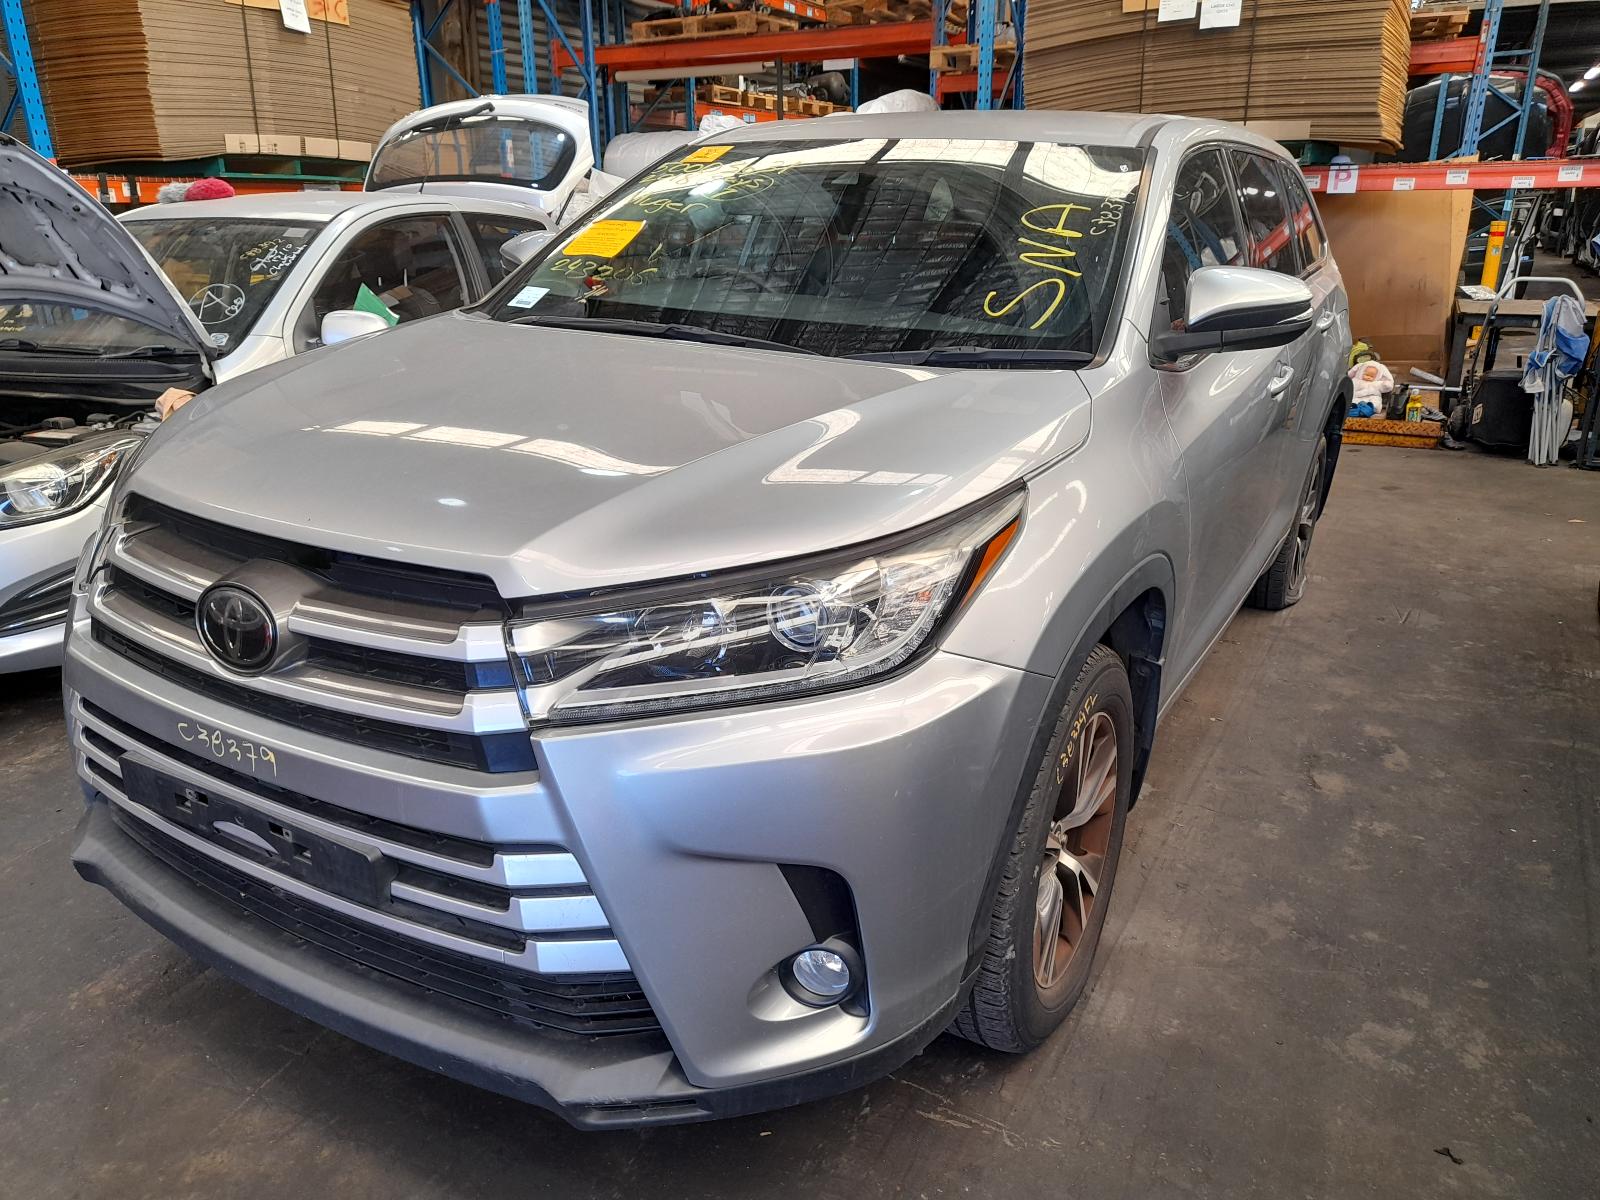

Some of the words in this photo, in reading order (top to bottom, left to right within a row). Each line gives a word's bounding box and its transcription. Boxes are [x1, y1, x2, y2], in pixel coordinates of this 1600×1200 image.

[1333, 169, 1352, 191] P
[983, 202, 1092, 330] SNA
[177, 721, 278, 778] C38379
